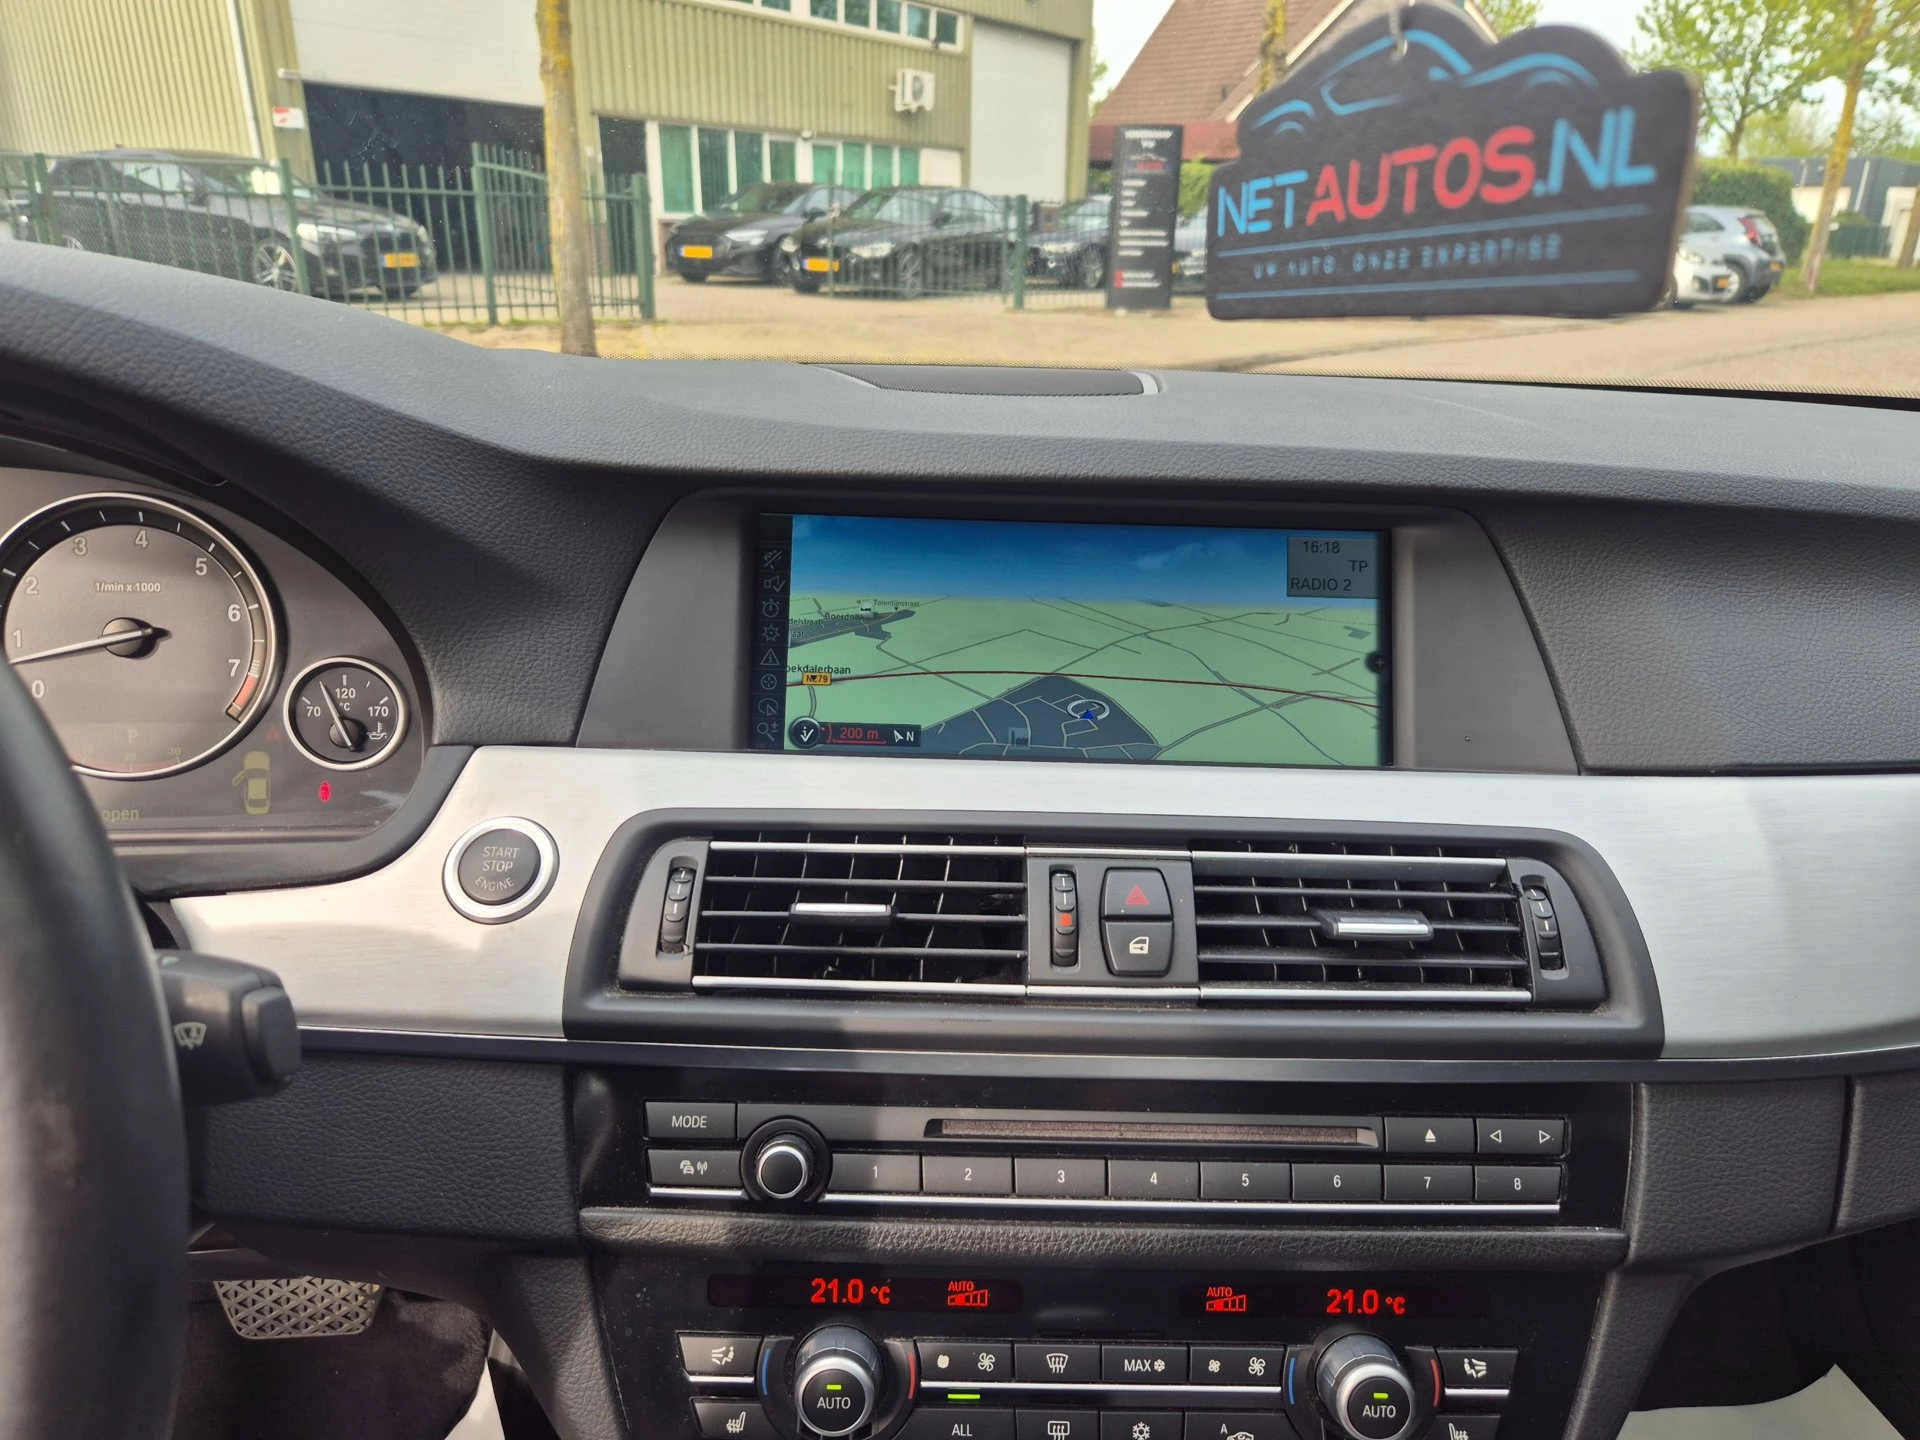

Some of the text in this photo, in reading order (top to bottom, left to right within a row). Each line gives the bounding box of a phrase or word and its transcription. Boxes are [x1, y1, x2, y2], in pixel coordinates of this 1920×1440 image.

[73, 536, 88, 555] 3
[135, 530, 148, 548] 4
[1303, 541, 1340, 554] 16:18
[195, 558, 208, 576] 5
[1348, 560, 1368, 572] TP
[25, 577, 39, 594] 2
[95, 582, 121, 593] 1/min
[135, 582, 161, 593] 1000
[1290, 577, 1352, 591] RADIO 2
[228, 605, 241, 622] 6
[12, 631, 23, 647] 1
[228, 659, 240, 676] 7
[32, 680, 45, 697] 0
[335, 688, 356, 699] 120
[306, 706, 321, 717] 70
[368, 706, 389, 717] 170
[840, 727, 879, 739] 200 m
[906, 731, 915, 741] N
[101, 808, 139, 823] open
[483, 847, 520, 858] START
[482, 861, 513, 872] STOP
[475, 876, 515, 891] ENGINE
[671, 1115, 707, 1129] MODE
[872, 1165, 878, 1179] 1
[964, 1168, 972, 1181] 2
[1057, 1170, 1065, 1183] 3
[1150, 1172, 1158, 1185] 4
[1241, 1173, 1249, 1187] 5
[1333, 1175, 1341, 1188] 6
[1424, 1177, 1431, 1190] 7
[1513, 1178, 1522, 1191] 8
[811, 1278, 864, 1304] 21.0
[947, 1281, 974, 1291] AUTO
[1206, 1287, 1233, 1297] AUTO
[1326, 1289, 1379, 1315] 21.0
[1124, 1359, 1152, 1372] MAX
[817, 1397, 851, 1410] AUTO
[1362, 1405, 1397, 1418] AUTO
[951, 1424, 973, 1437] ALL
[1220, 1423, 1228, 1435] A
